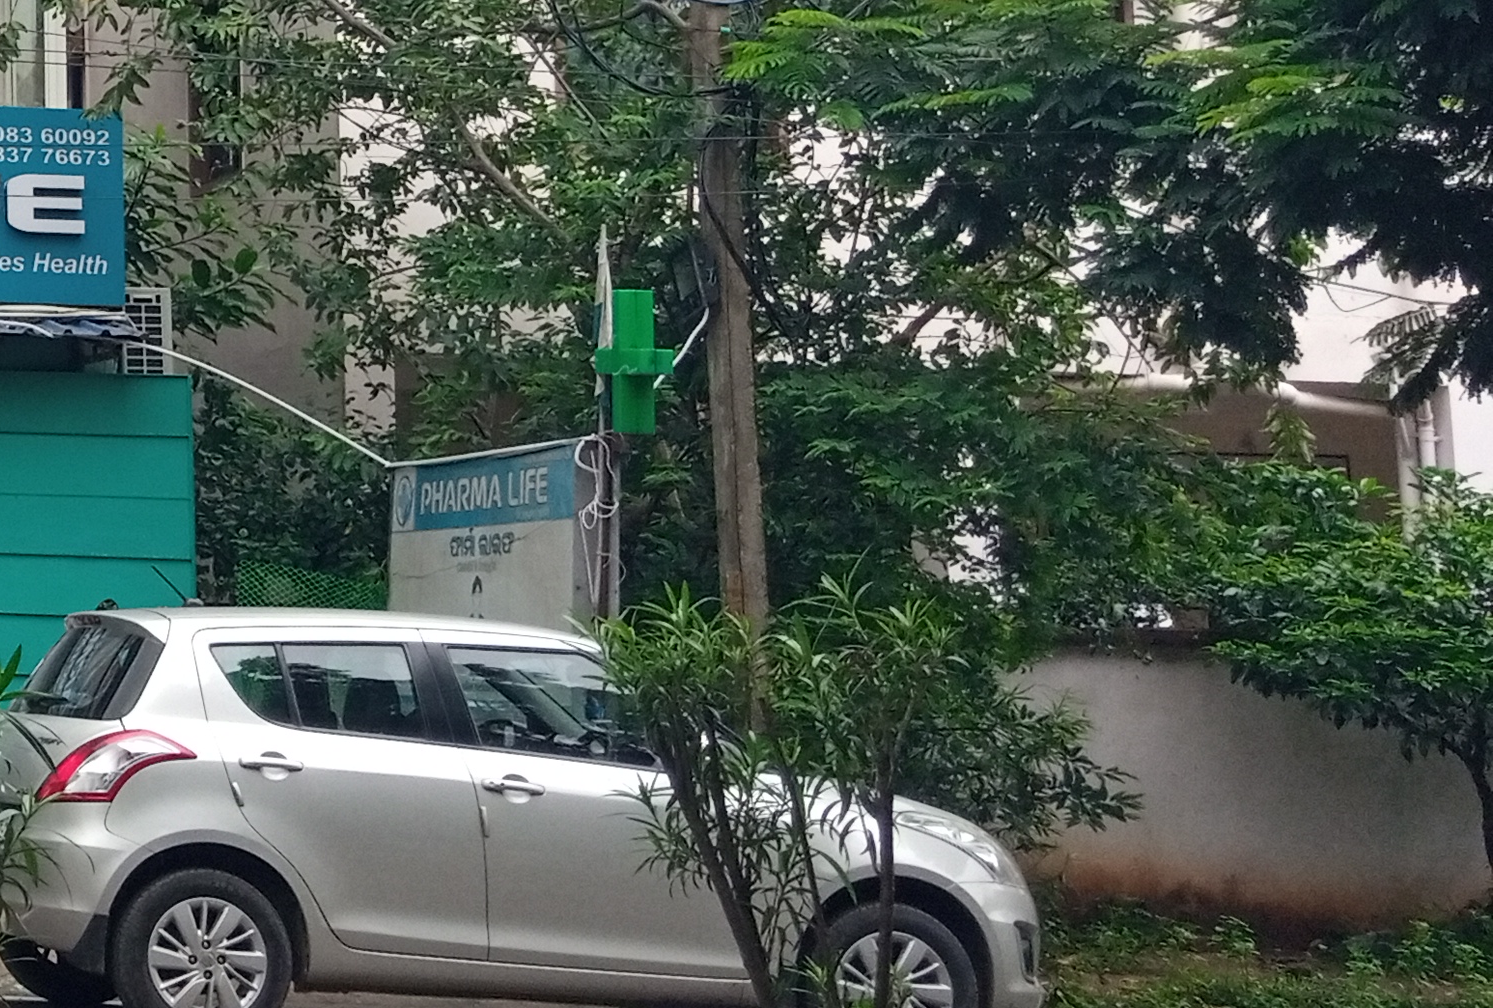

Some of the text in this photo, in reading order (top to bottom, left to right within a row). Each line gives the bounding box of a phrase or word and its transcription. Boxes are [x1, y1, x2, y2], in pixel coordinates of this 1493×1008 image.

[41, 128, 111, 146] 60092
[41, 148, 111, 166] 76673
[32, 252, 109, 276] Health
[419, 466, 548, 515] PHARMA LIFE
